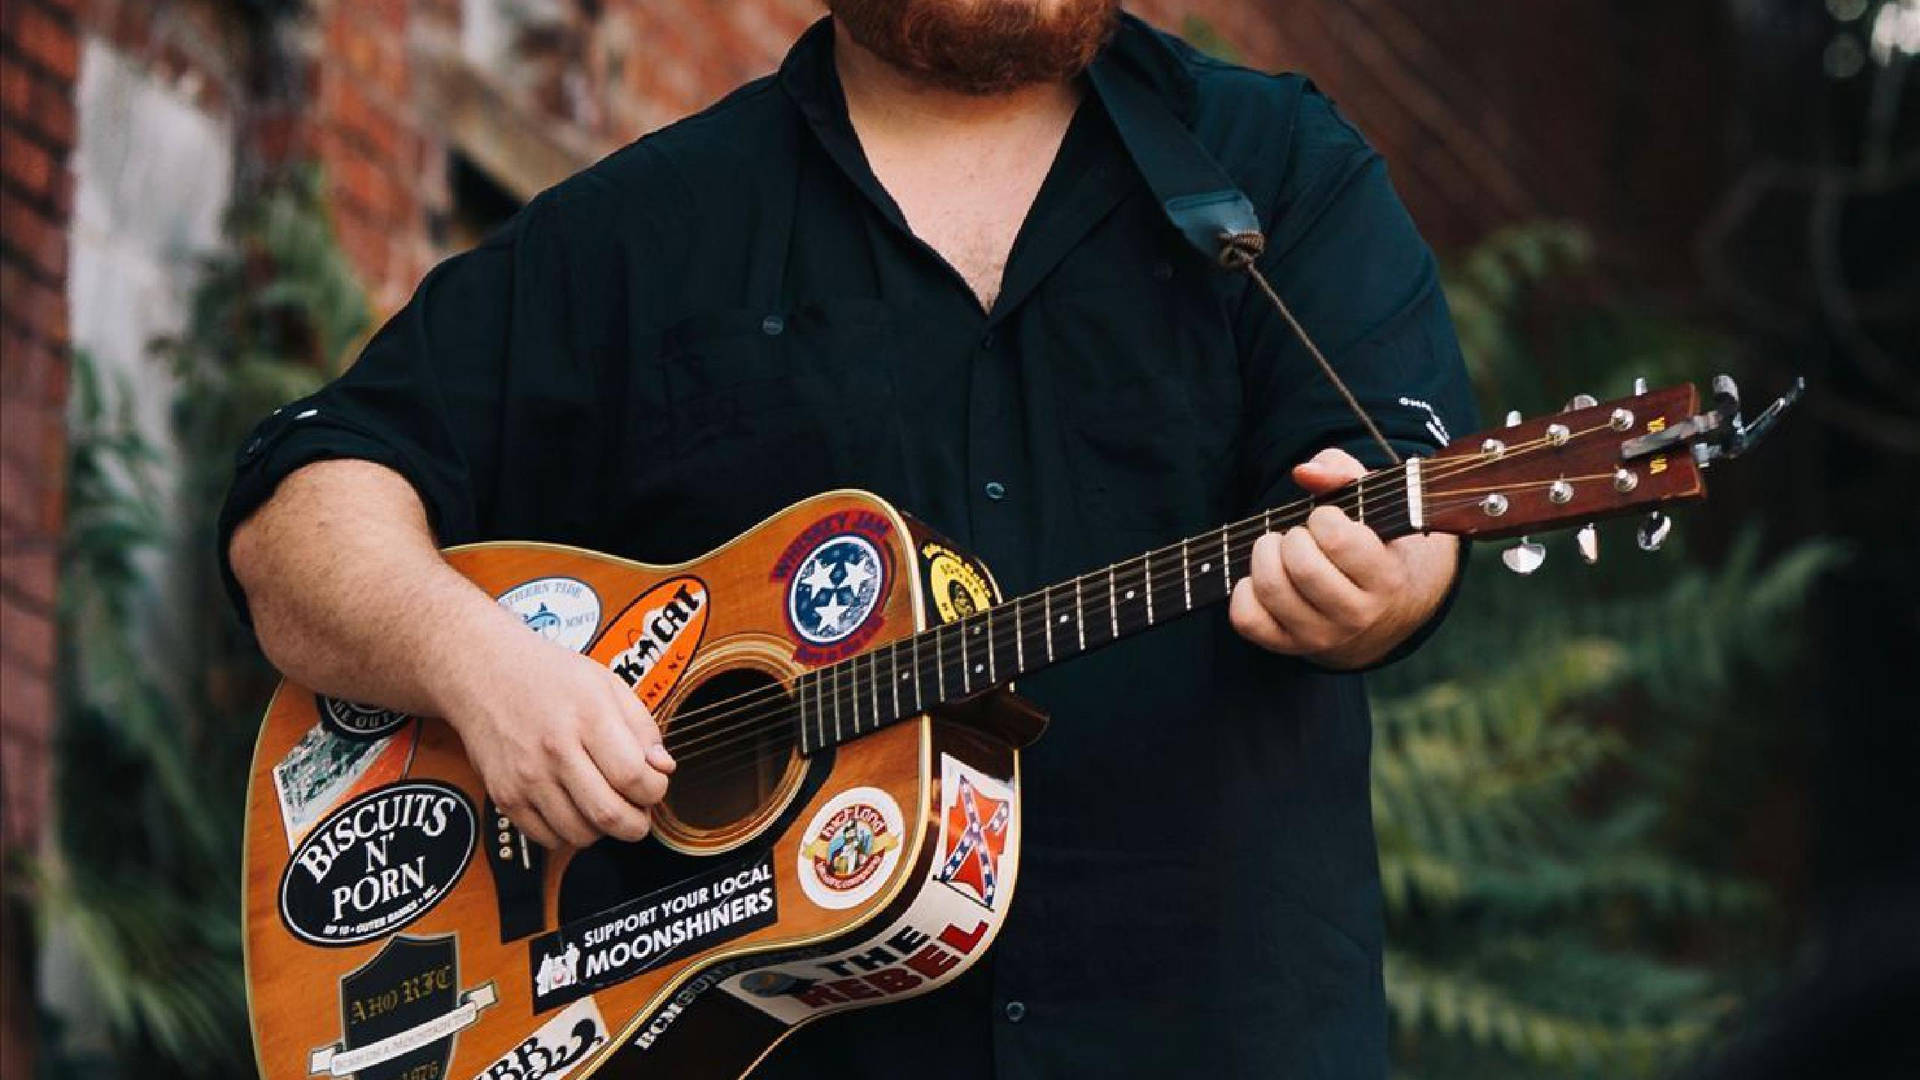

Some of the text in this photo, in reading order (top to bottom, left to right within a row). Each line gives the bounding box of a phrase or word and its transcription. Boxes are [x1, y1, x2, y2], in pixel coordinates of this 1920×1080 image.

[651, 583, 700, 644] CAT
[298, 794, 455, 883] BISCUITS
[365, 832, 394, 873] N'
[332, 856, 425, 920] PORN
[584, 864, 772, 948] SUPPORT YOUR LOCAL
[585, 887, 774, 978] MOONSHINERS
[795, 920, 990, 1008] REBEL
[815, 924, 931, 977] THE
